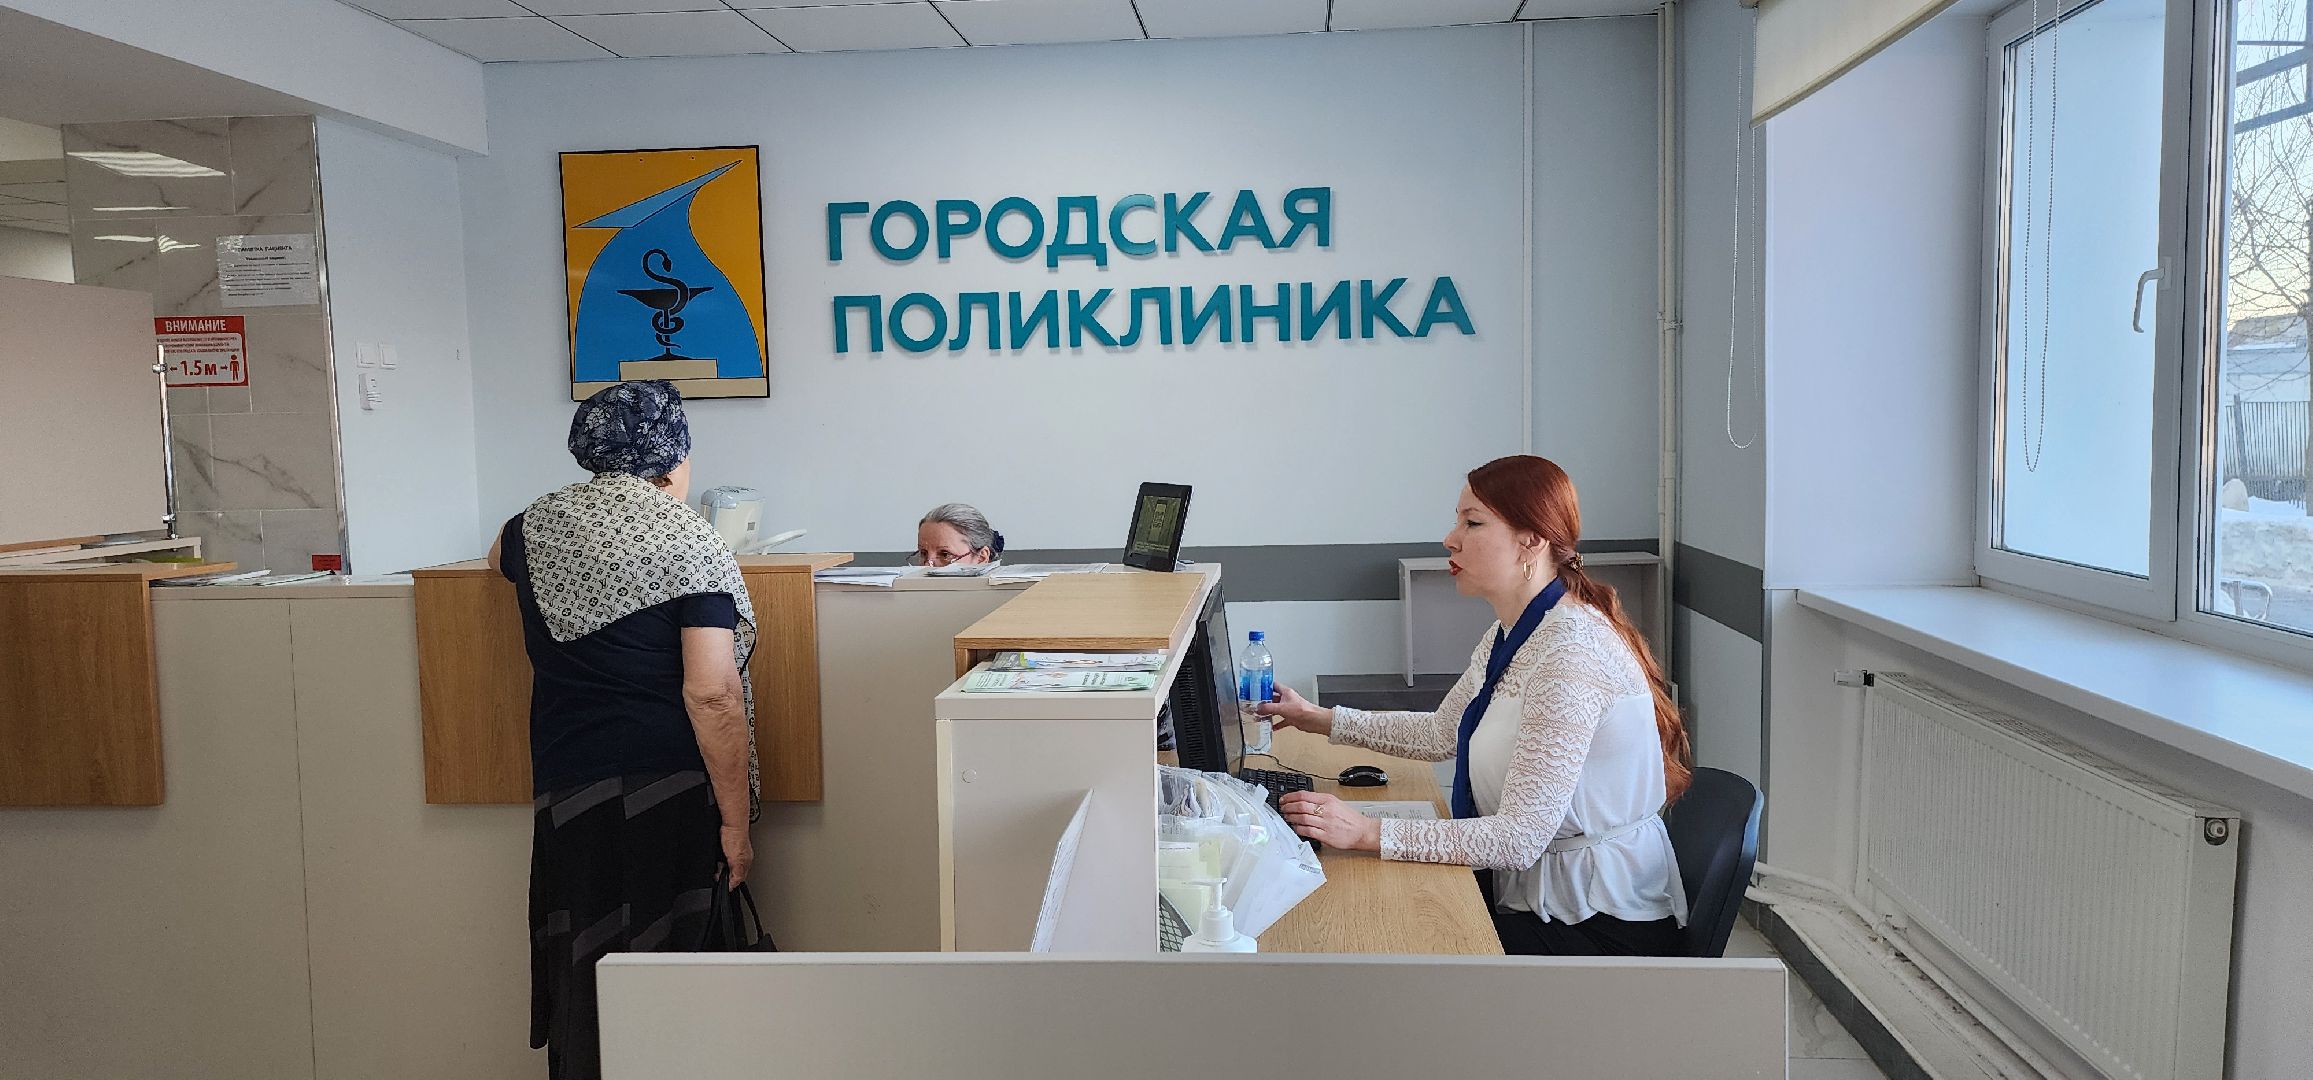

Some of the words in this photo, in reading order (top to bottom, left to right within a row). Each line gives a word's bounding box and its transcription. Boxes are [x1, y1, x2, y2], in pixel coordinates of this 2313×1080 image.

[828, 187, 1330, 268] ГОРОДСКАЯ
[165, 319, 227, 332] ВНИМАНИЕ
[834, 277, 1475, 353] ПОЛИКЛИНИКА
[180, 360, 203, 376] 1.5
